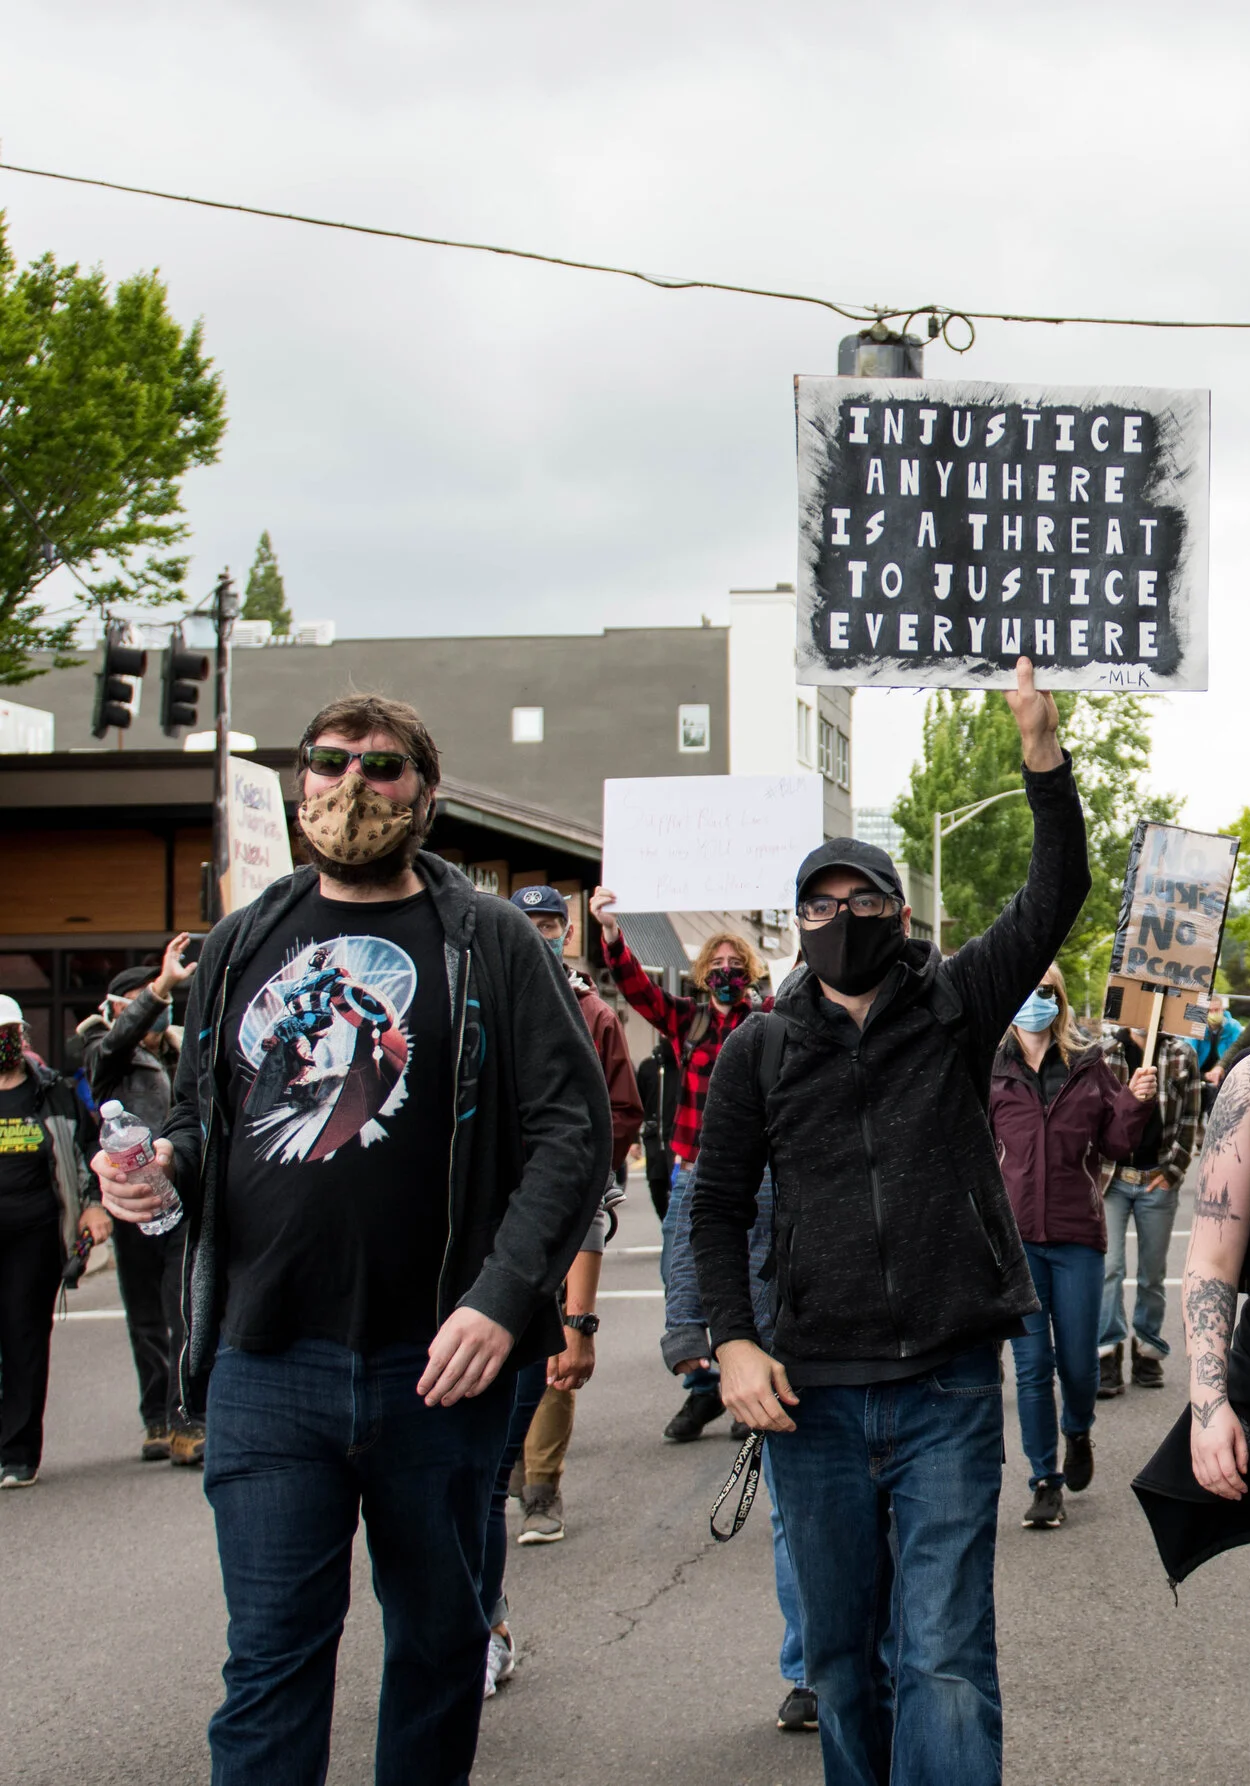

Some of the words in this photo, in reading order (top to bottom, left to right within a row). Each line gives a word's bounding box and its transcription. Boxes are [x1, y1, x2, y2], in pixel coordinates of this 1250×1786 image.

[848, 406, 1143, 453] INJUSTICE
[866, 457, 1125, 503] ANYWHERE
[831, 508, 885, 545] IS
[917, 511, 937, 548] A
[968, 513, 1158, 555] THREAT
[848, 560, 903, 599] TO
[933, 563, 1158, 606] JUSTICE
[829, 611, 1158, 658] EVERYWHERE
[737, 1469, 759, 1519] BREWING
